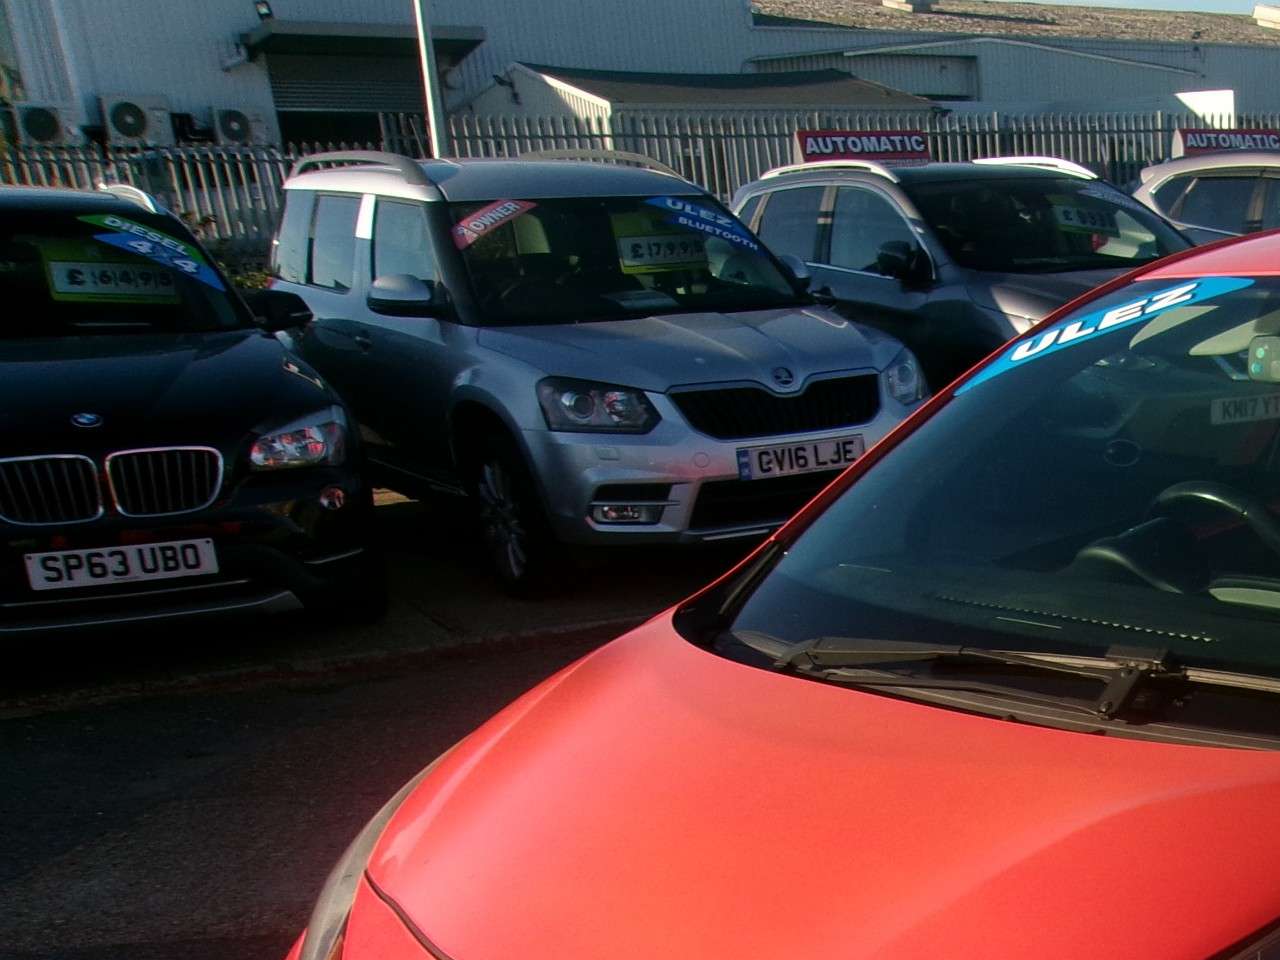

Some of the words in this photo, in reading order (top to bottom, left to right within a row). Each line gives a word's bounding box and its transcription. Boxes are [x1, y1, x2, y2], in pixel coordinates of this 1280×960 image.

[806, 135, 926, 154] AUTOMATIC
[1186, 132, 1280, 149] AUTOMATIC
[468, 201, 521, 231] OWNER
[665, 197, 733, 228] ULEZ
[104, 216, 189, 255] DIESEL
[678, 216, 759, 251] BLUETOOTH
[1010, 281, 1201, 362] ULEZ
[758, 446, 809, 474] GV16
[41, 550, 131, 583] SP63
[136, 542, 202, 574] UBO
